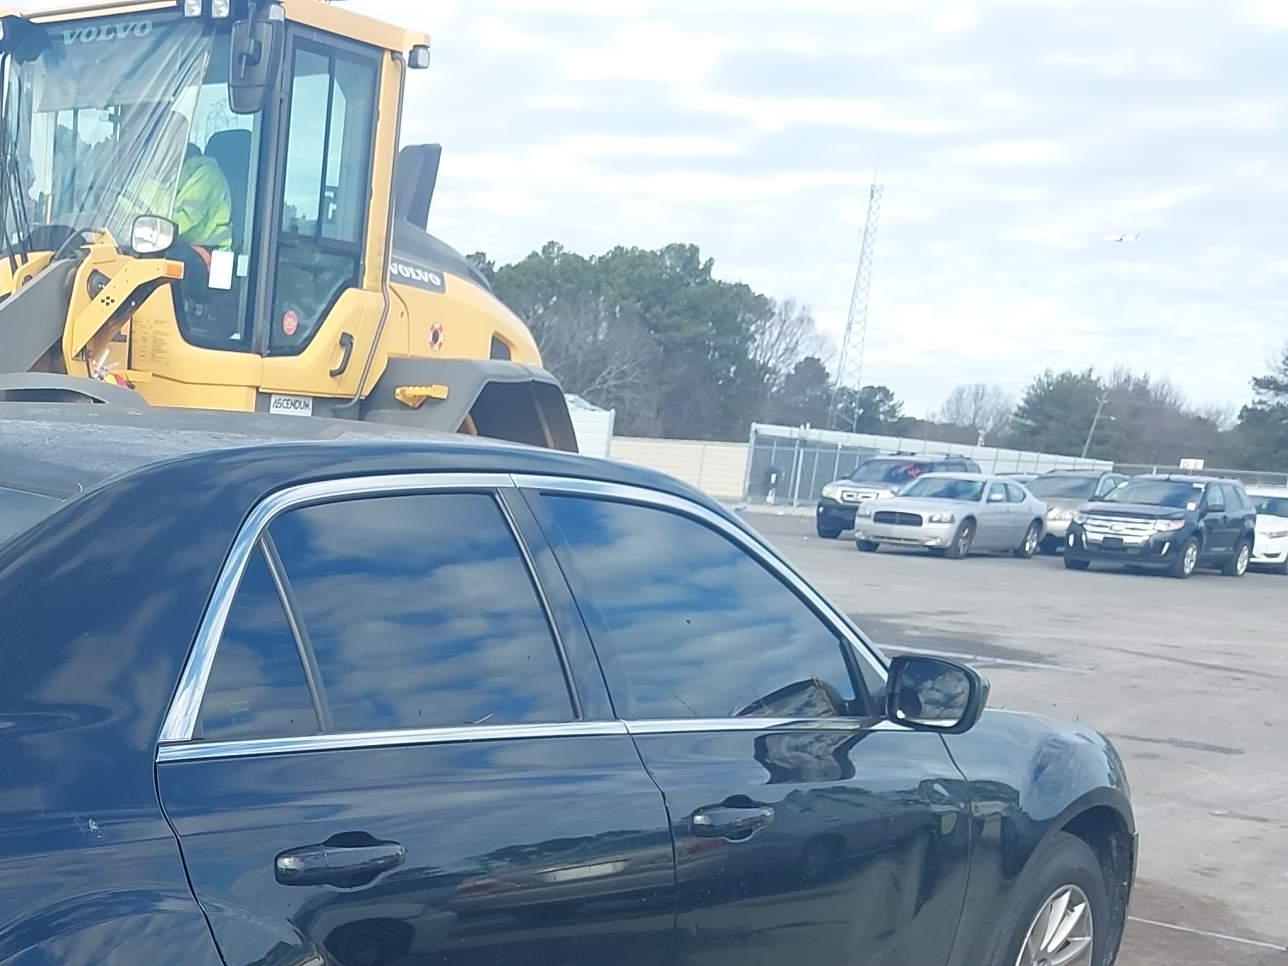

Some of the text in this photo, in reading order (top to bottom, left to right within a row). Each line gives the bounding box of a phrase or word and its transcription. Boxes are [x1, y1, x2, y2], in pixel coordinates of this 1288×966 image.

[61, 20, 153, 46] VOLVO
[390, 263, 441, 287] VOLVO
[272, 398, 311, 411] ASCENDUM
